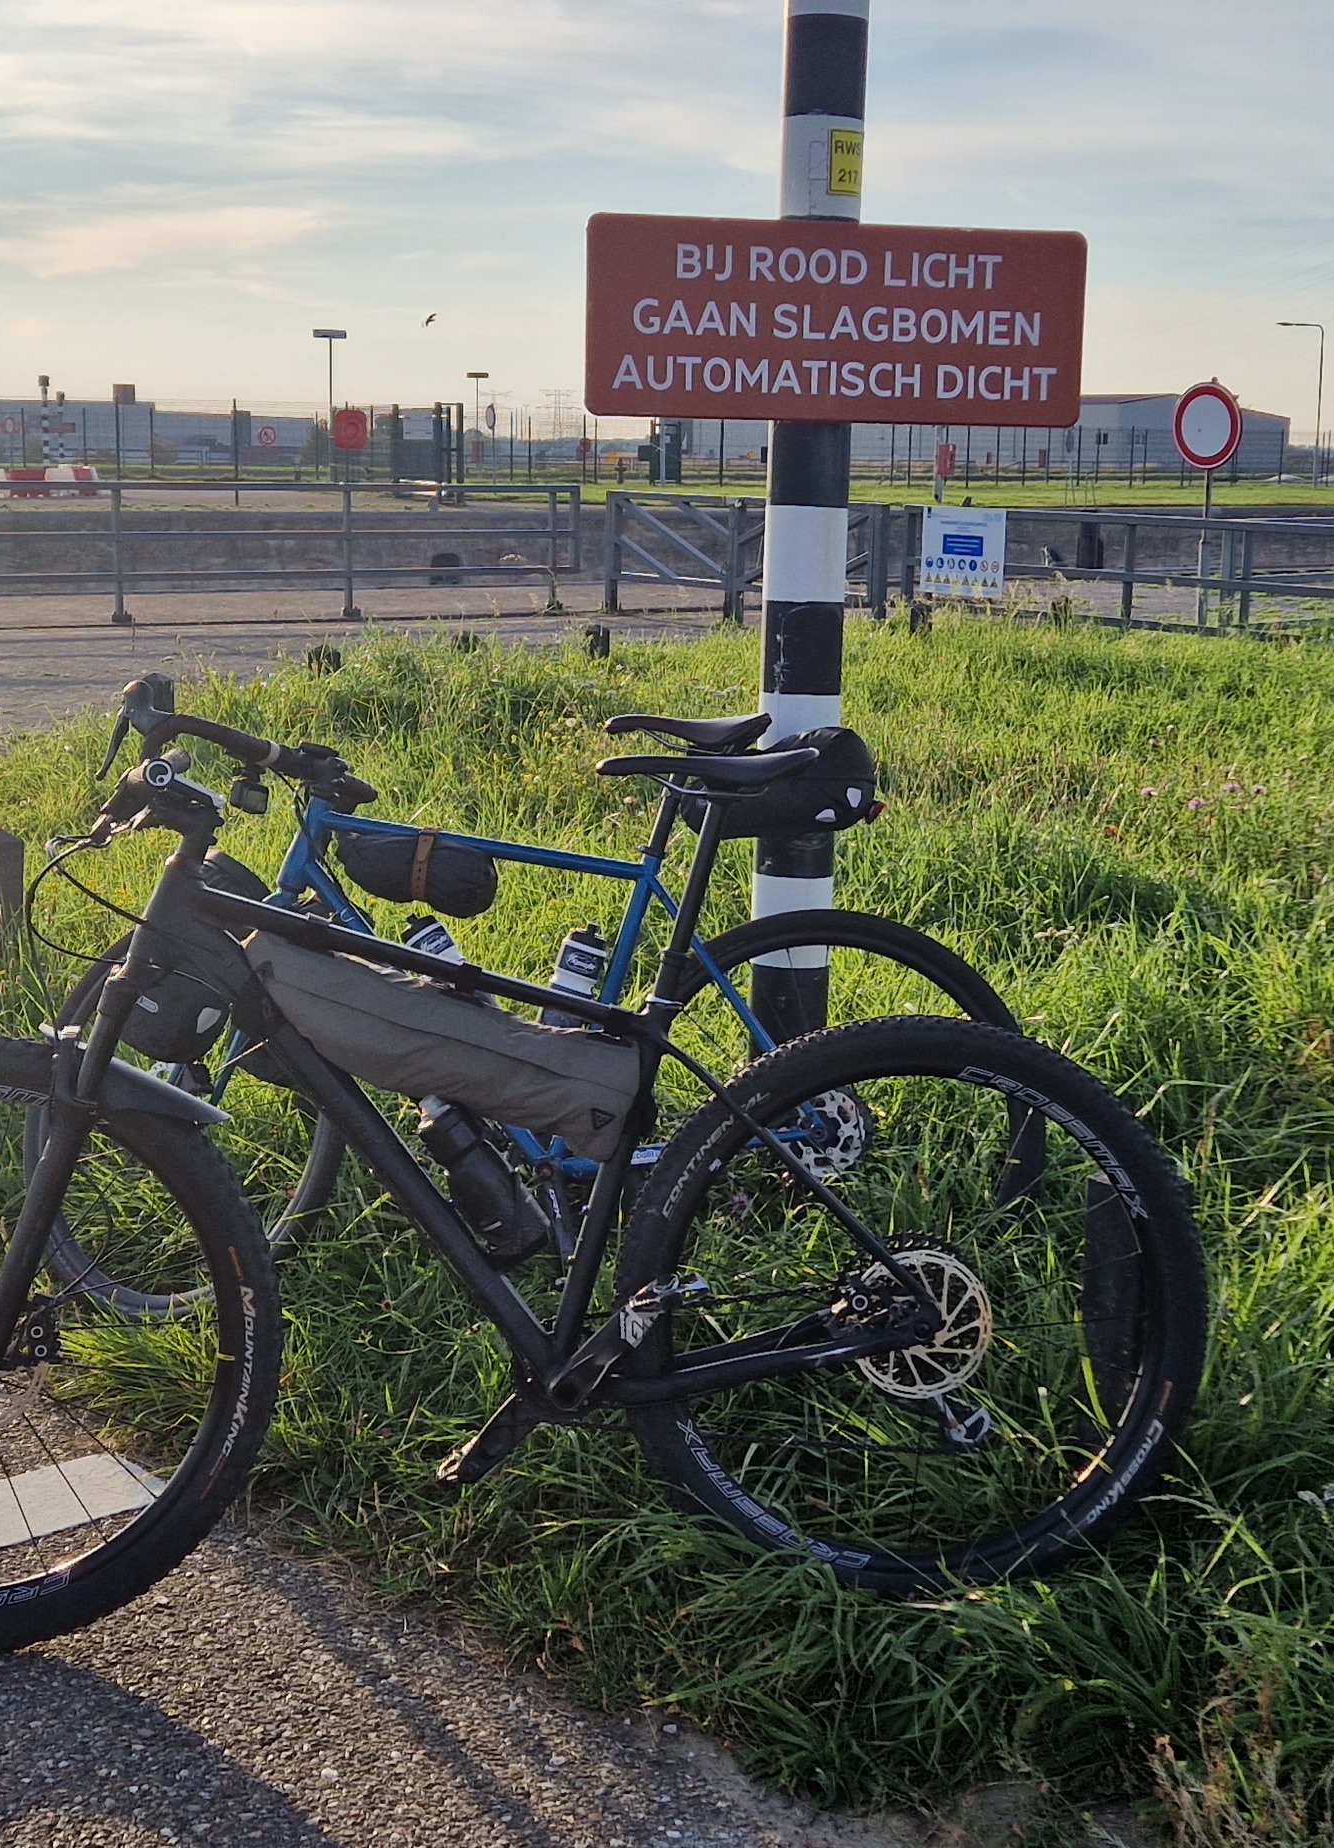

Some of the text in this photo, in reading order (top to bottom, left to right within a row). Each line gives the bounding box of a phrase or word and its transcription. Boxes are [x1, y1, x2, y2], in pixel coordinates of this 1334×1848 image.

[834, 140, 862, 156] RWS
[838, 168, 858, 184] 217
[677, 244, 1002, 289] BIJ ROOD LICHT
[634, 299, 1041, 346] GAAN SLAGBOMEN
[613, 355, 1057, 401] AUTOMATISCH DICHT
[662, 1093, 770, 1218] CONTINENAL
[958, 1066, 1148, 1220] CROSSMAX
[676, 1418, 872, 1569] CROSSMAX
